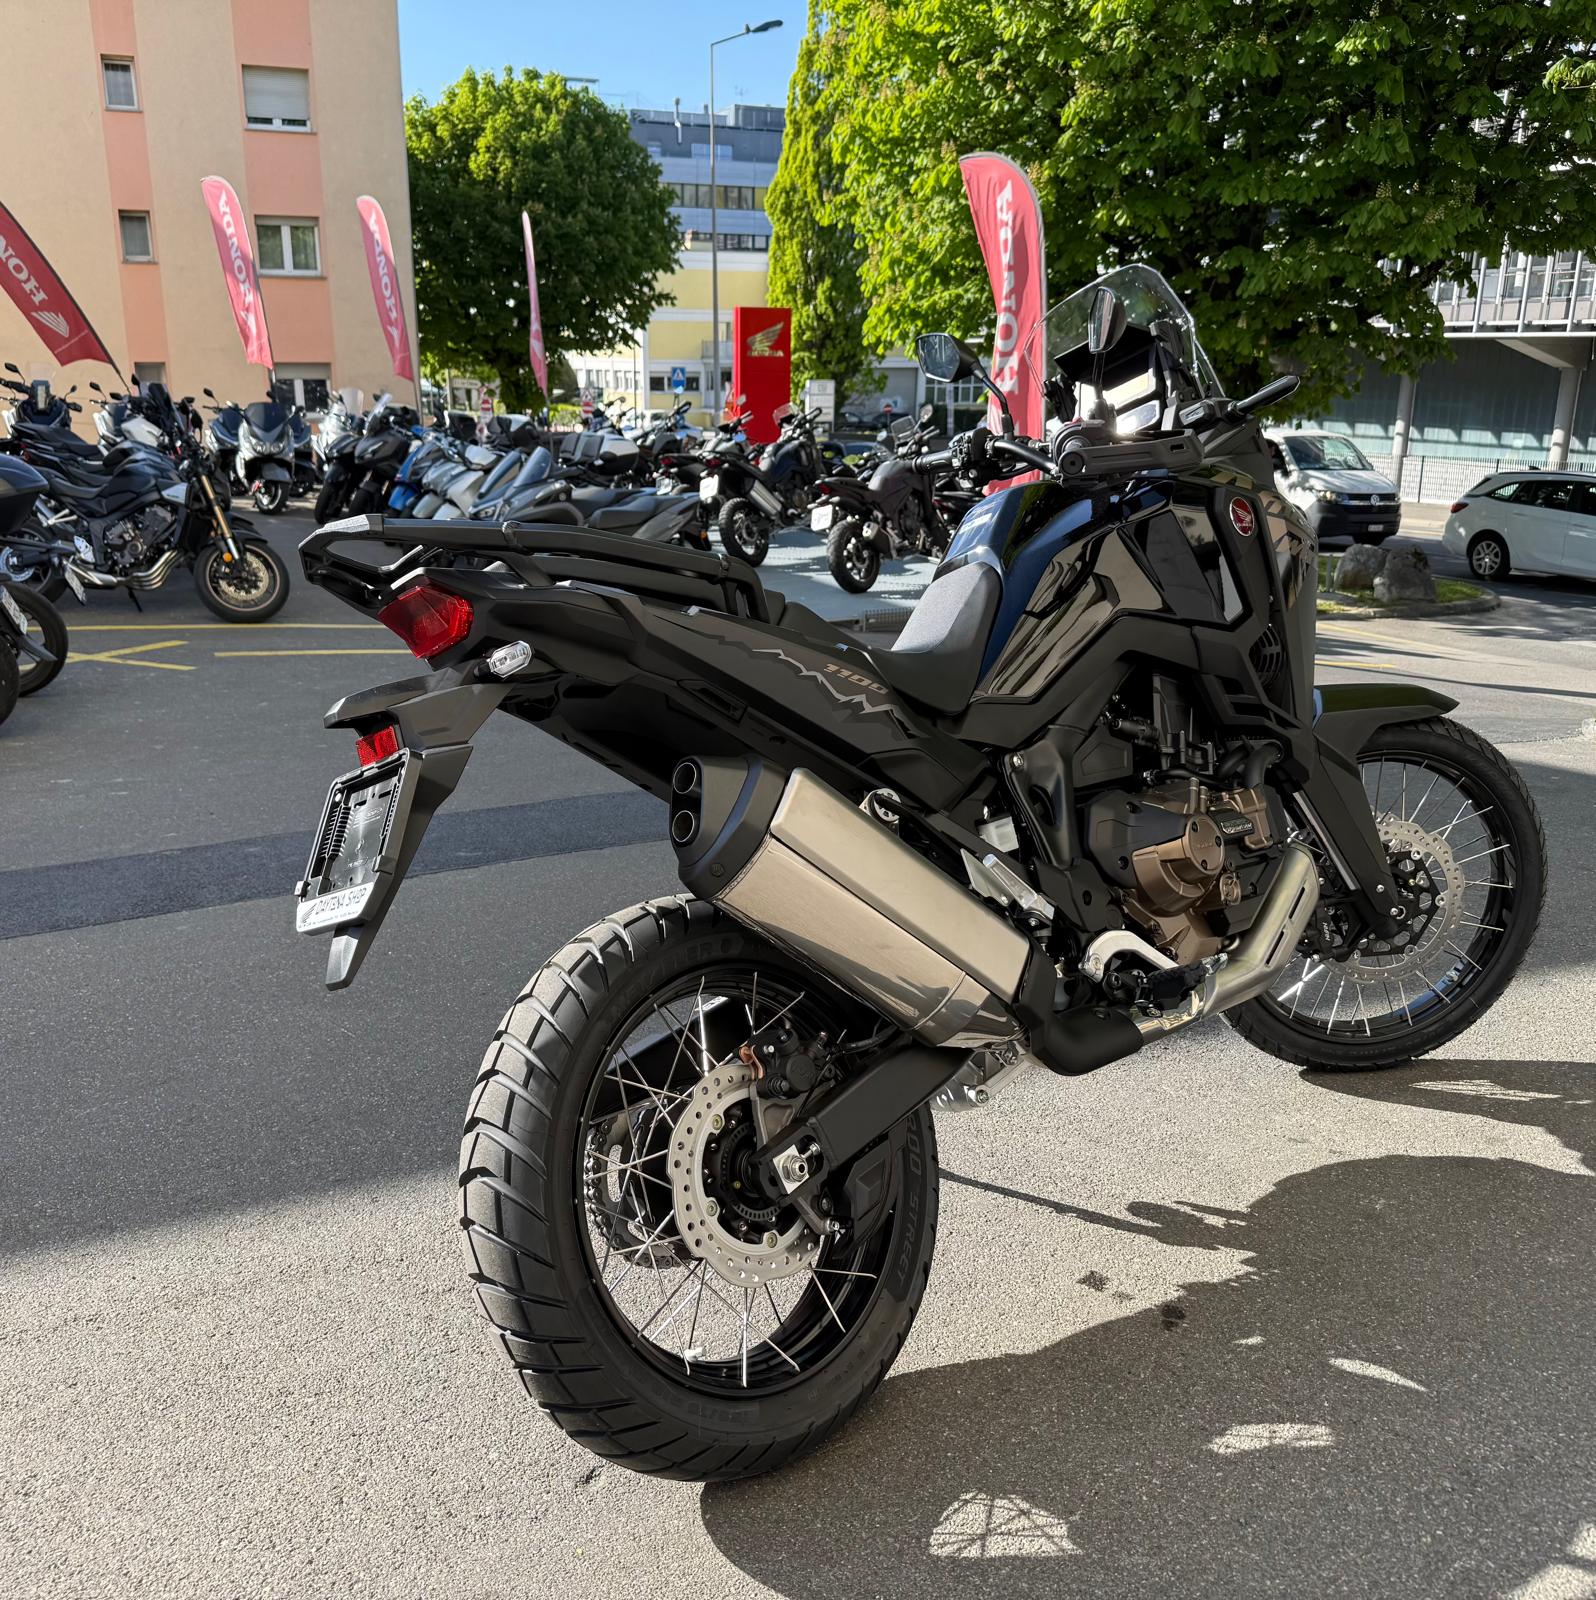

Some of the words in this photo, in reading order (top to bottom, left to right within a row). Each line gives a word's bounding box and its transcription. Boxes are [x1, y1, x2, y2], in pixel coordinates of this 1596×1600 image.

[218, 190, 254, 307] HONDA
[369, 208, 399, 326] HONDA
[995, 179, 1020, 395] HONDA
[823, 663, 888, 693] 1100
[897, 1191, 919, 1287] STREET
